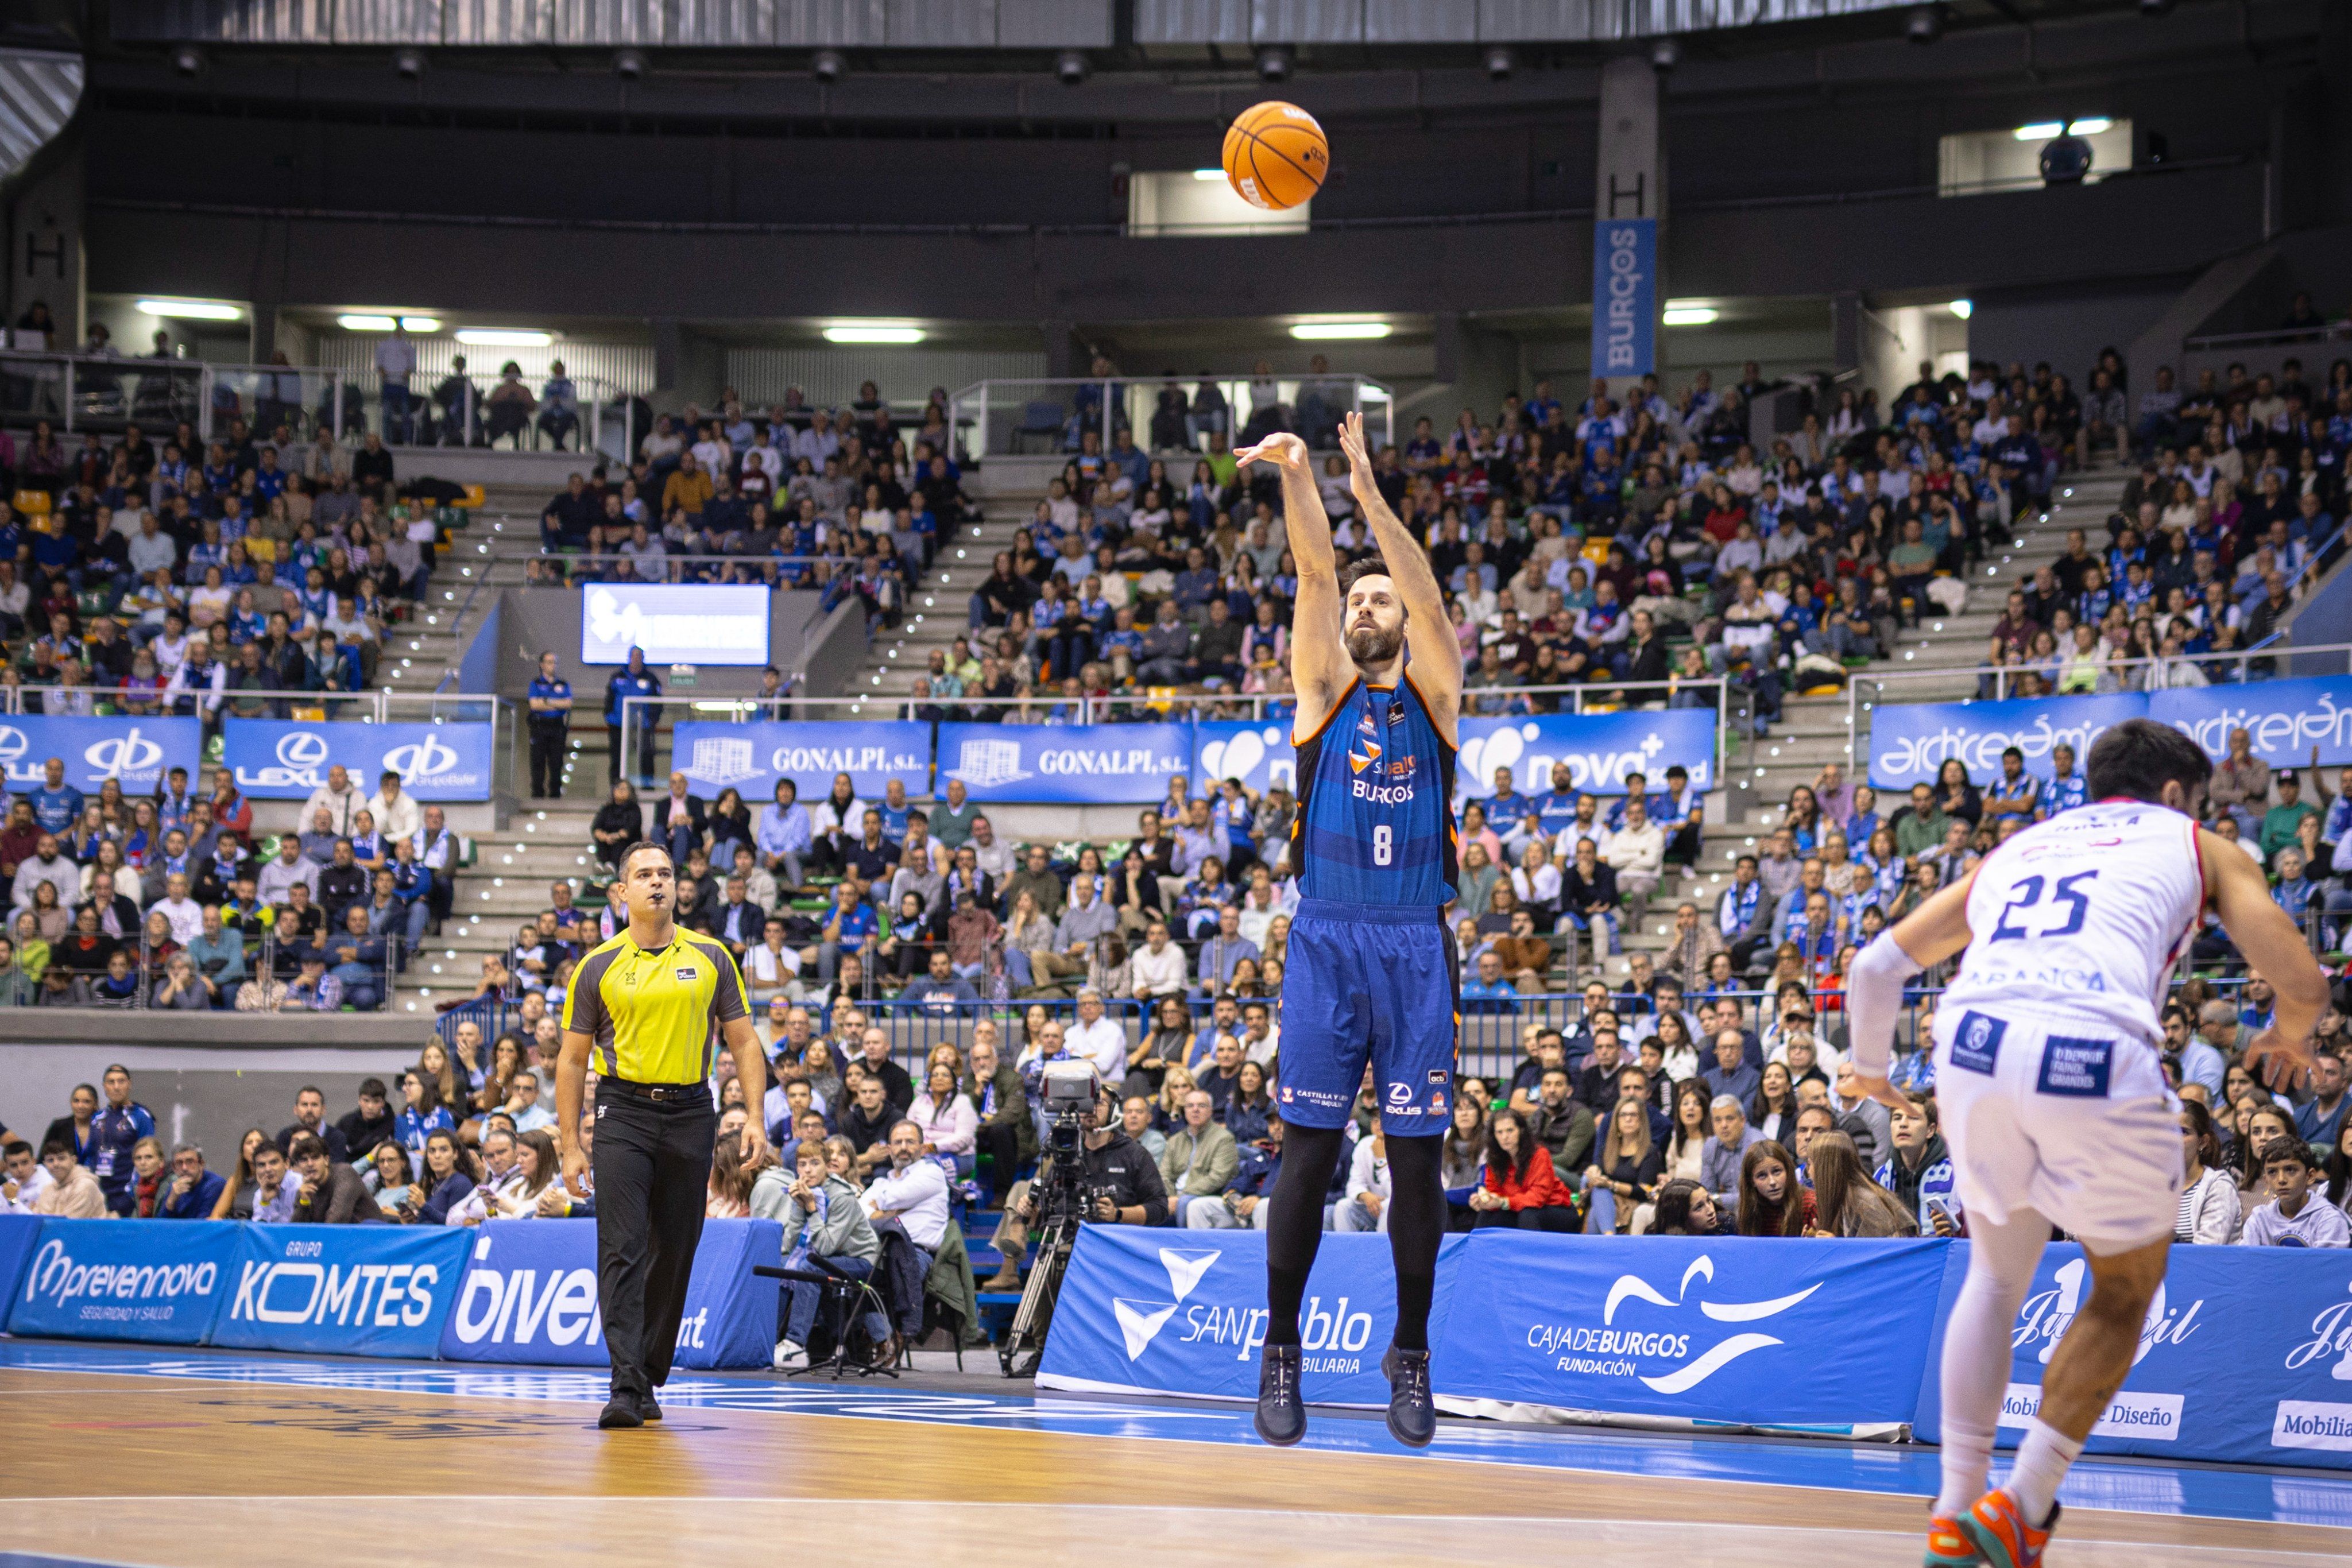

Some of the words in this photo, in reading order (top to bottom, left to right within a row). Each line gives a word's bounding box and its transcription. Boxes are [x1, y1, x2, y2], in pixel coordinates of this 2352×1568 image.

[1608, 228, 1643, 368] BURGOS
[1352, 779, 1414, 808] BURGOS
[1374, 825, 1392, 866] 8
[1991, 869, 2099, 943] 25
[1297, 1090, 1332, 1100] CASTILLA
[286, 1241, 322, 1257] GRUPO
[57, 1261, 216, 1308] prevennova
[231, 1261, 438, 1327] KOMTES
[80, 1306, 131, 1320] SEGURIDAD
[141, 1306, 173, 1320] SALUD
[1180, 1296, 1372, 1361] SANpblo
[1557, 1356, 1636, 1377] FUNDACIÓN
[2111, 1406, 2172, 1426] Diseño
